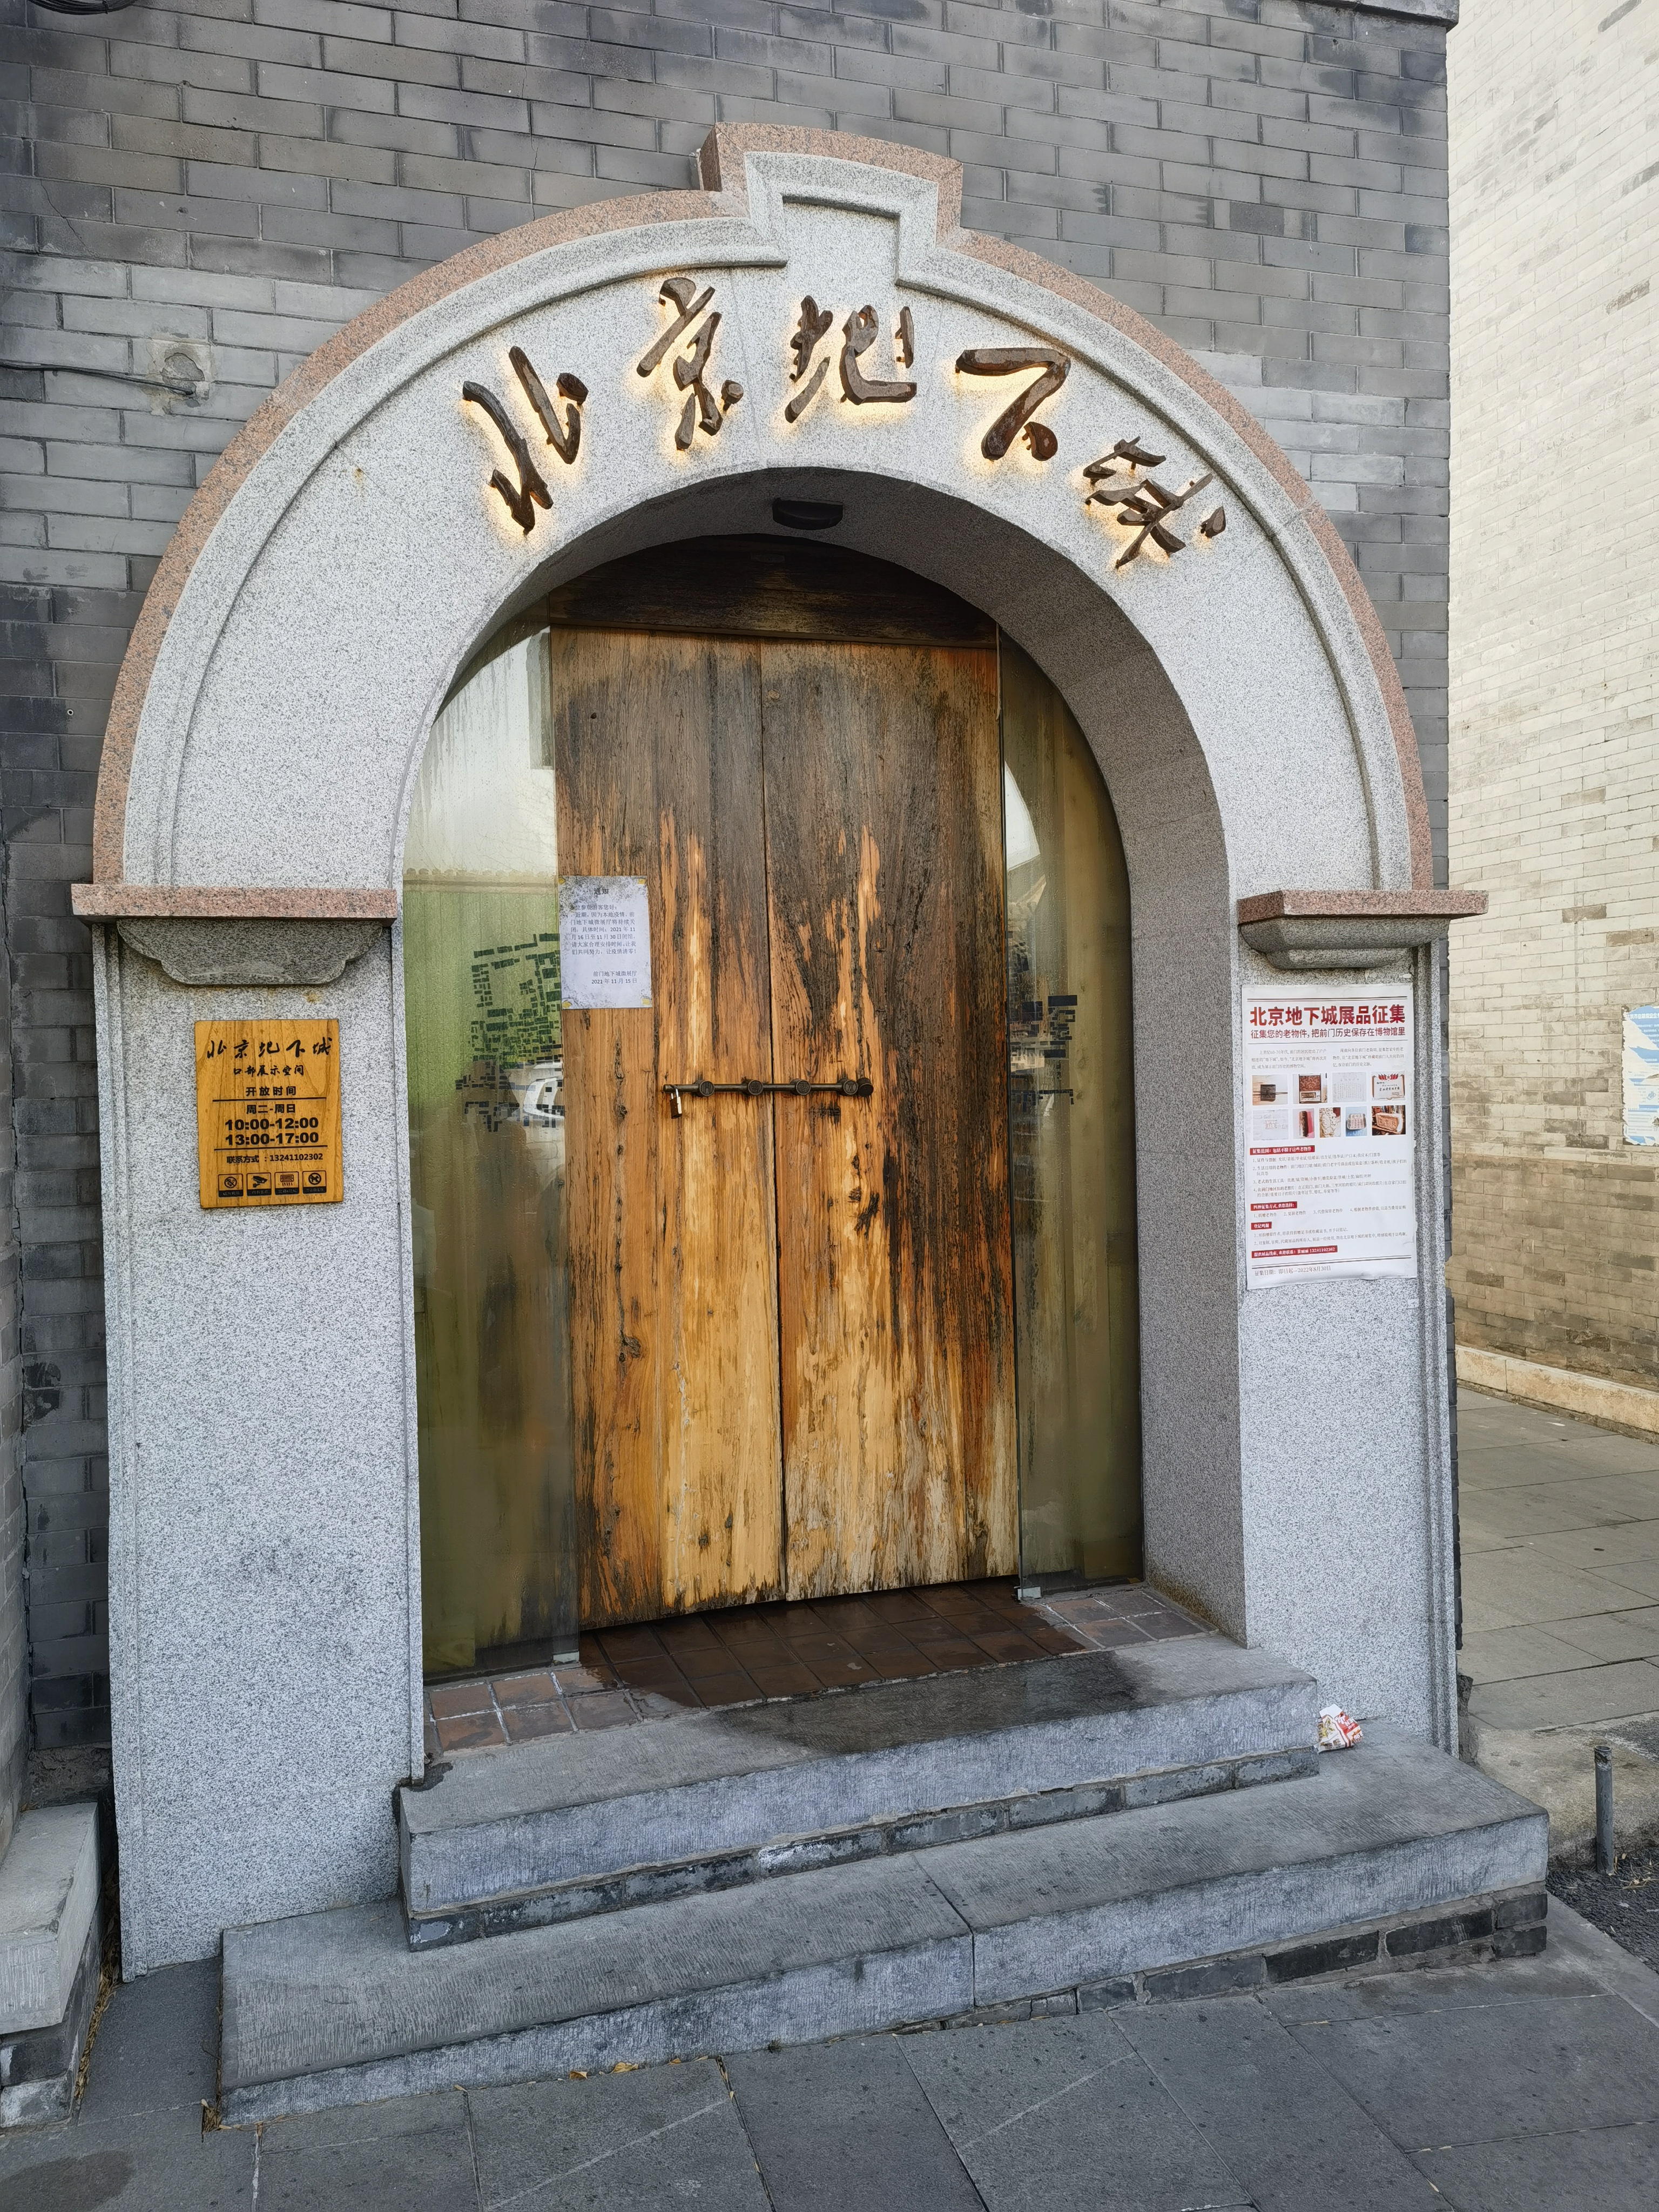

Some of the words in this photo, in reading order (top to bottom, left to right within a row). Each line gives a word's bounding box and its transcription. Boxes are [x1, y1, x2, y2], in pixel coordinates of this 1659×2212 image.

[462, 277, 1226, 568] 北京地下城
[1250, 1004, 1405, 1026] 北京地下城展品征集
[207, 1036, 333, 1058] 北京地下城
[233, 1064, 304, 1077] 口部展示空间
[246, 1086, 296, 1097] 开放时间
[246, 1104, 295, 1114] 周二-周日
[225, 1117, 319, 1131] 10:00-12:00
[225, 1132, 319, 1145] 13:00-17:00
